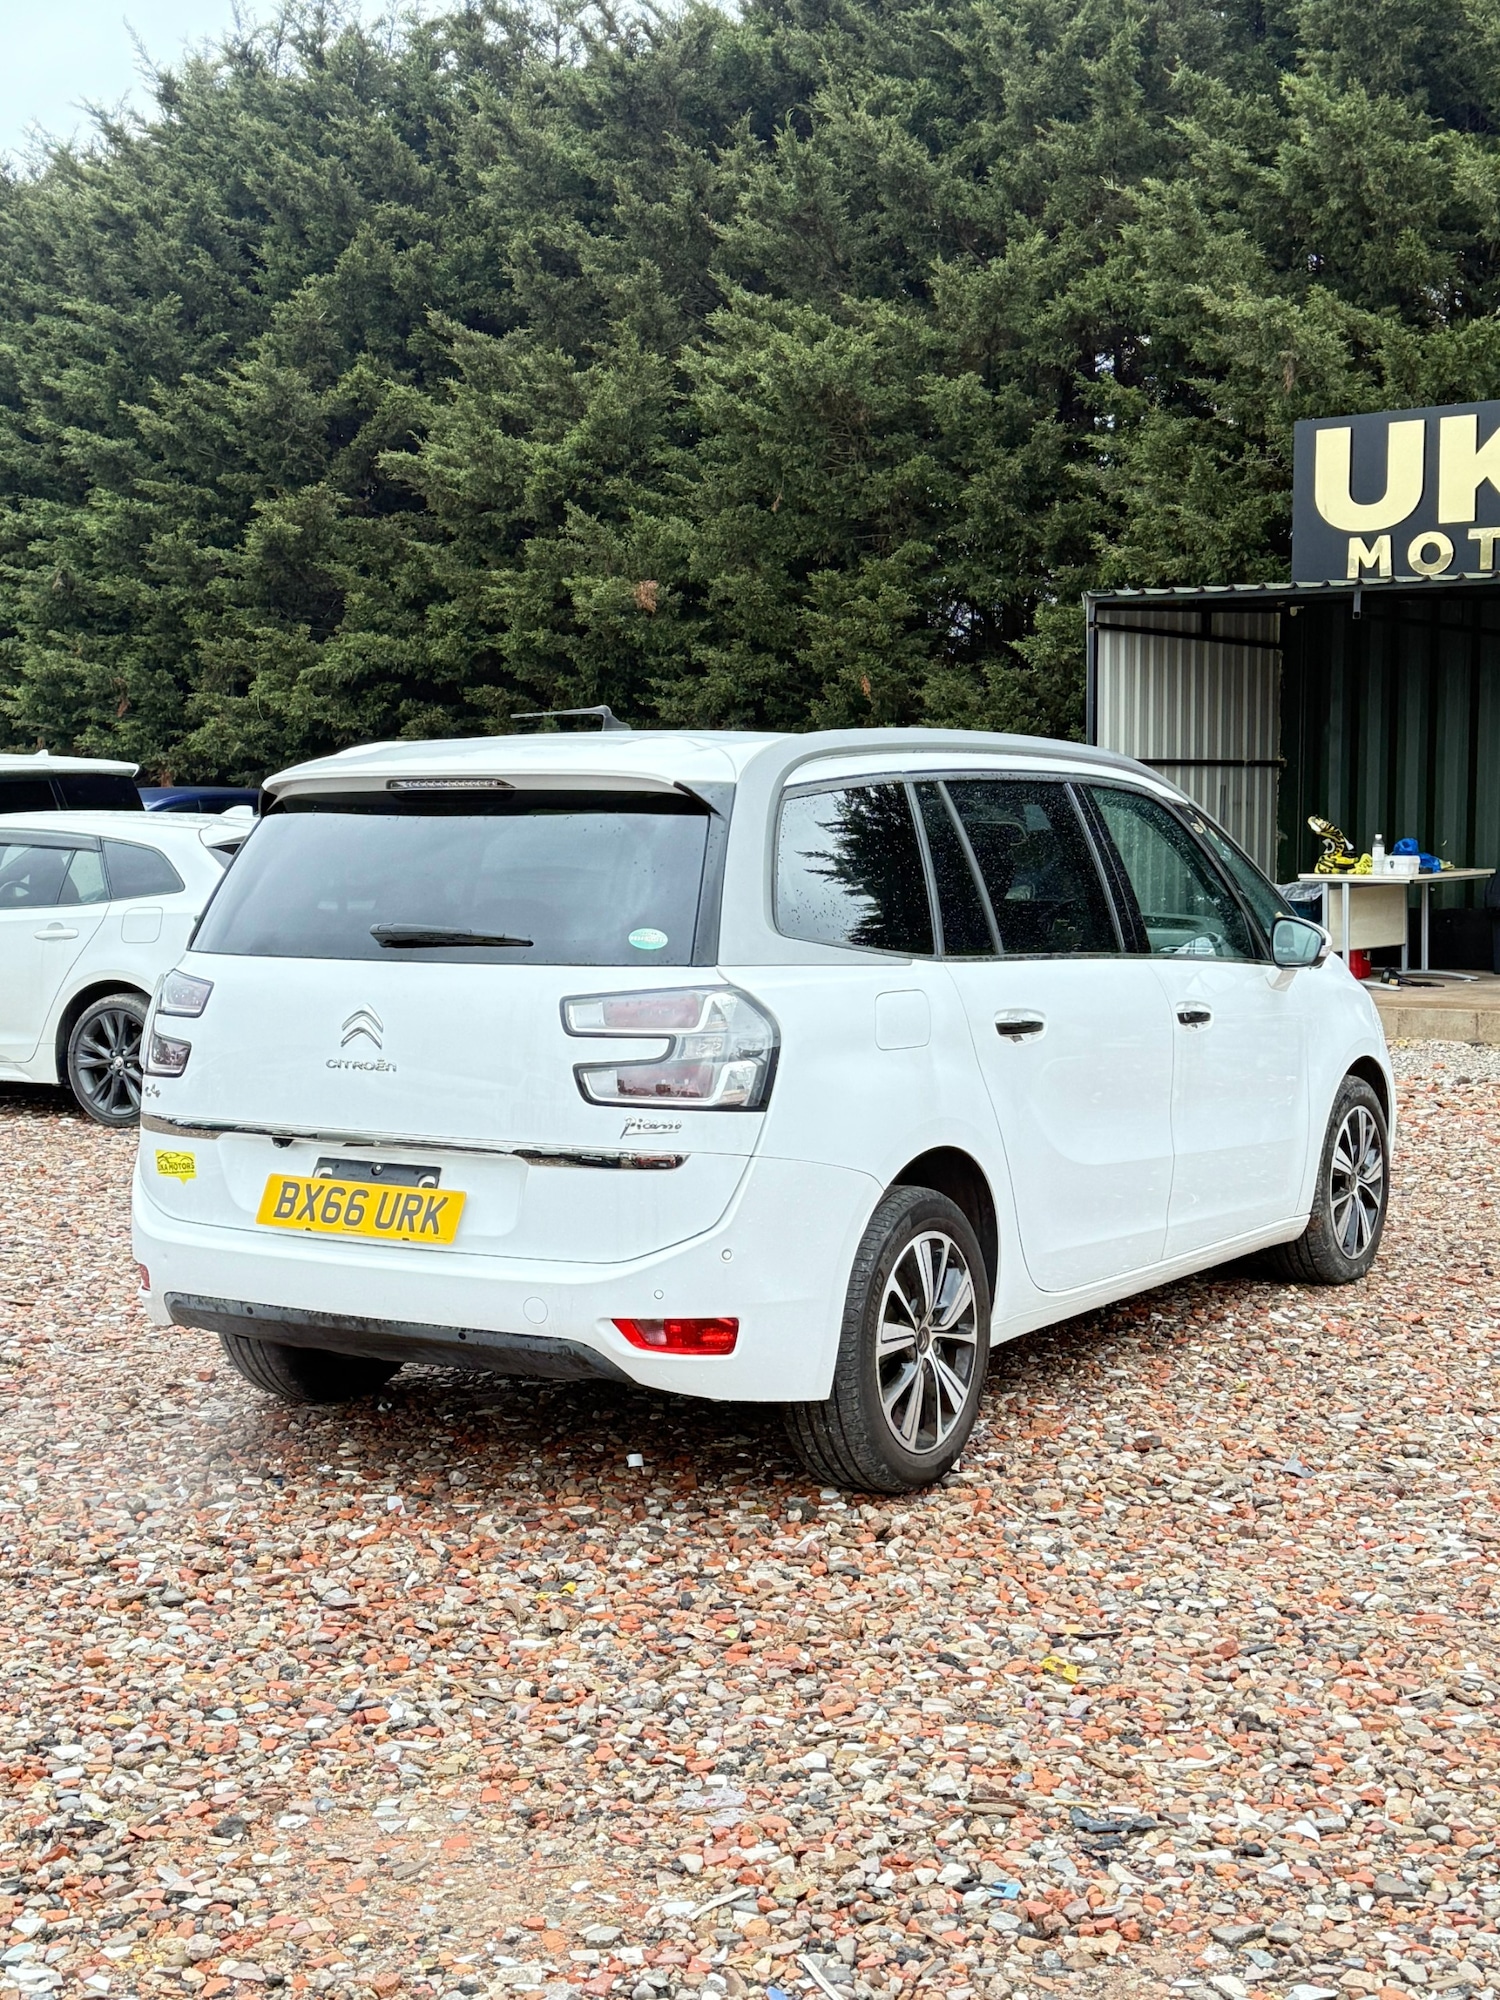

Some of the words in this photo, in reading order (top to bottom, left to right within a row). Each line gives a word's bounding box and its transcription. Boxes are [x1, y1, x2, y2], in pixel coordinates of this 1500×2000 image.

[1314, 413, 1500, 532] UK
[1347, 526, 1500, 579] MOT
[168, 1162, 195, 1171] MOTORS
[273, 1180, 370, 1227] BX66
[374, 1191, 449, 1236] URK
